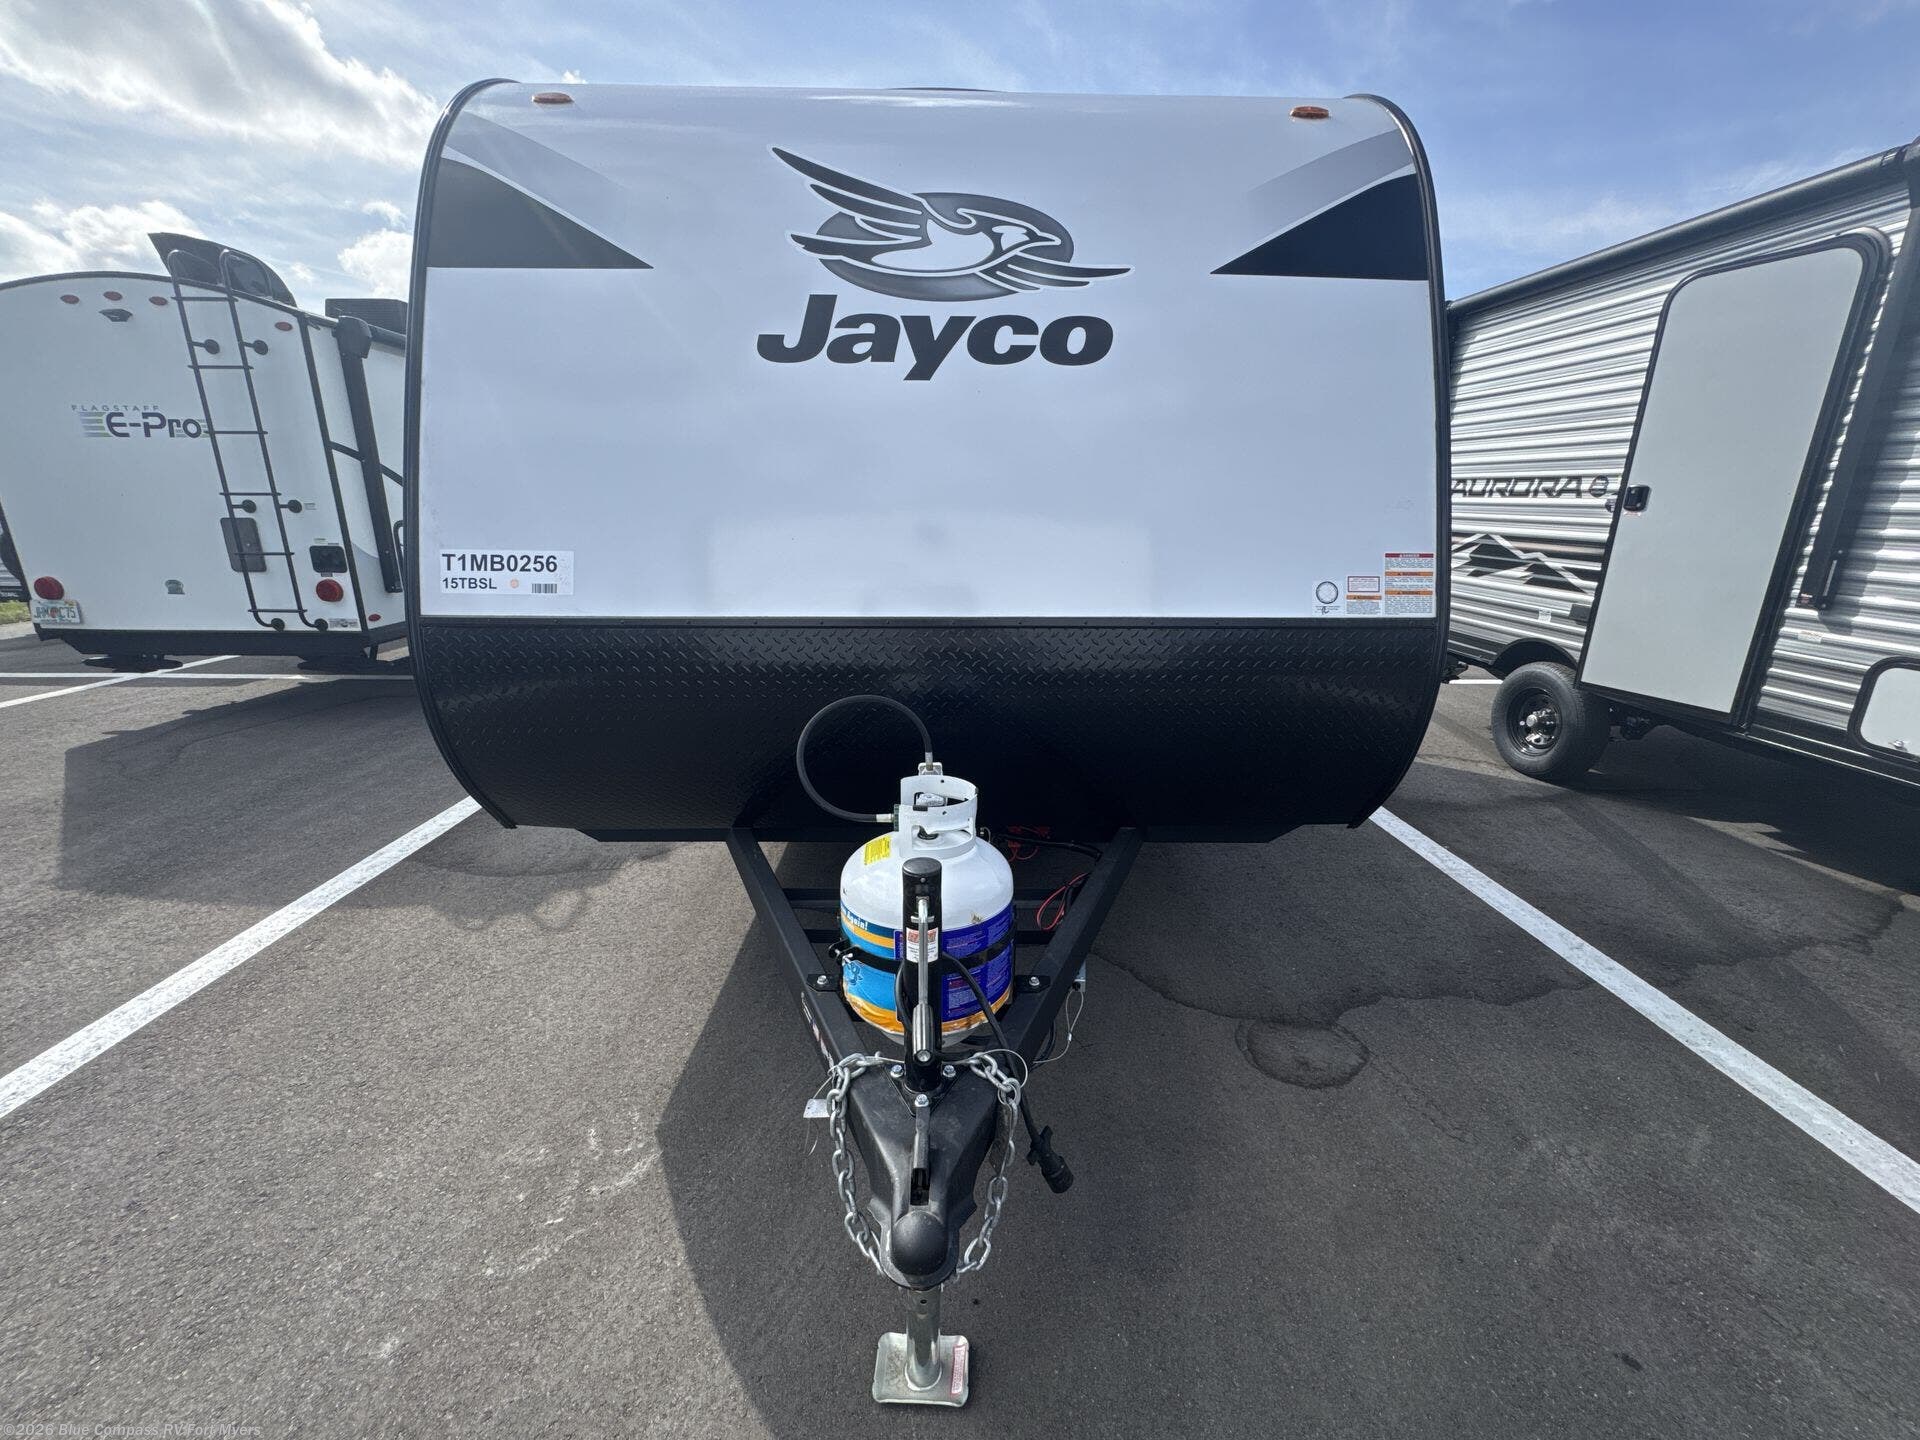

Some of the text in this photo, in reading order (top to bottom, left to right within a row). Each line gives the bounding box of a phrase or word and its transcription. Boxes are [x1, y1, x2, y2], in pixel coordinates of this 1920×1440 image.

[757, 294, 1114, 381] Jayco
[106, 411, 202, 438] E-Pro
[1451, 476, 1583, 499] AURORA
[442, 553, 558, 573] T1MB0256
[442, 577, 498, 589] 15TBSL
